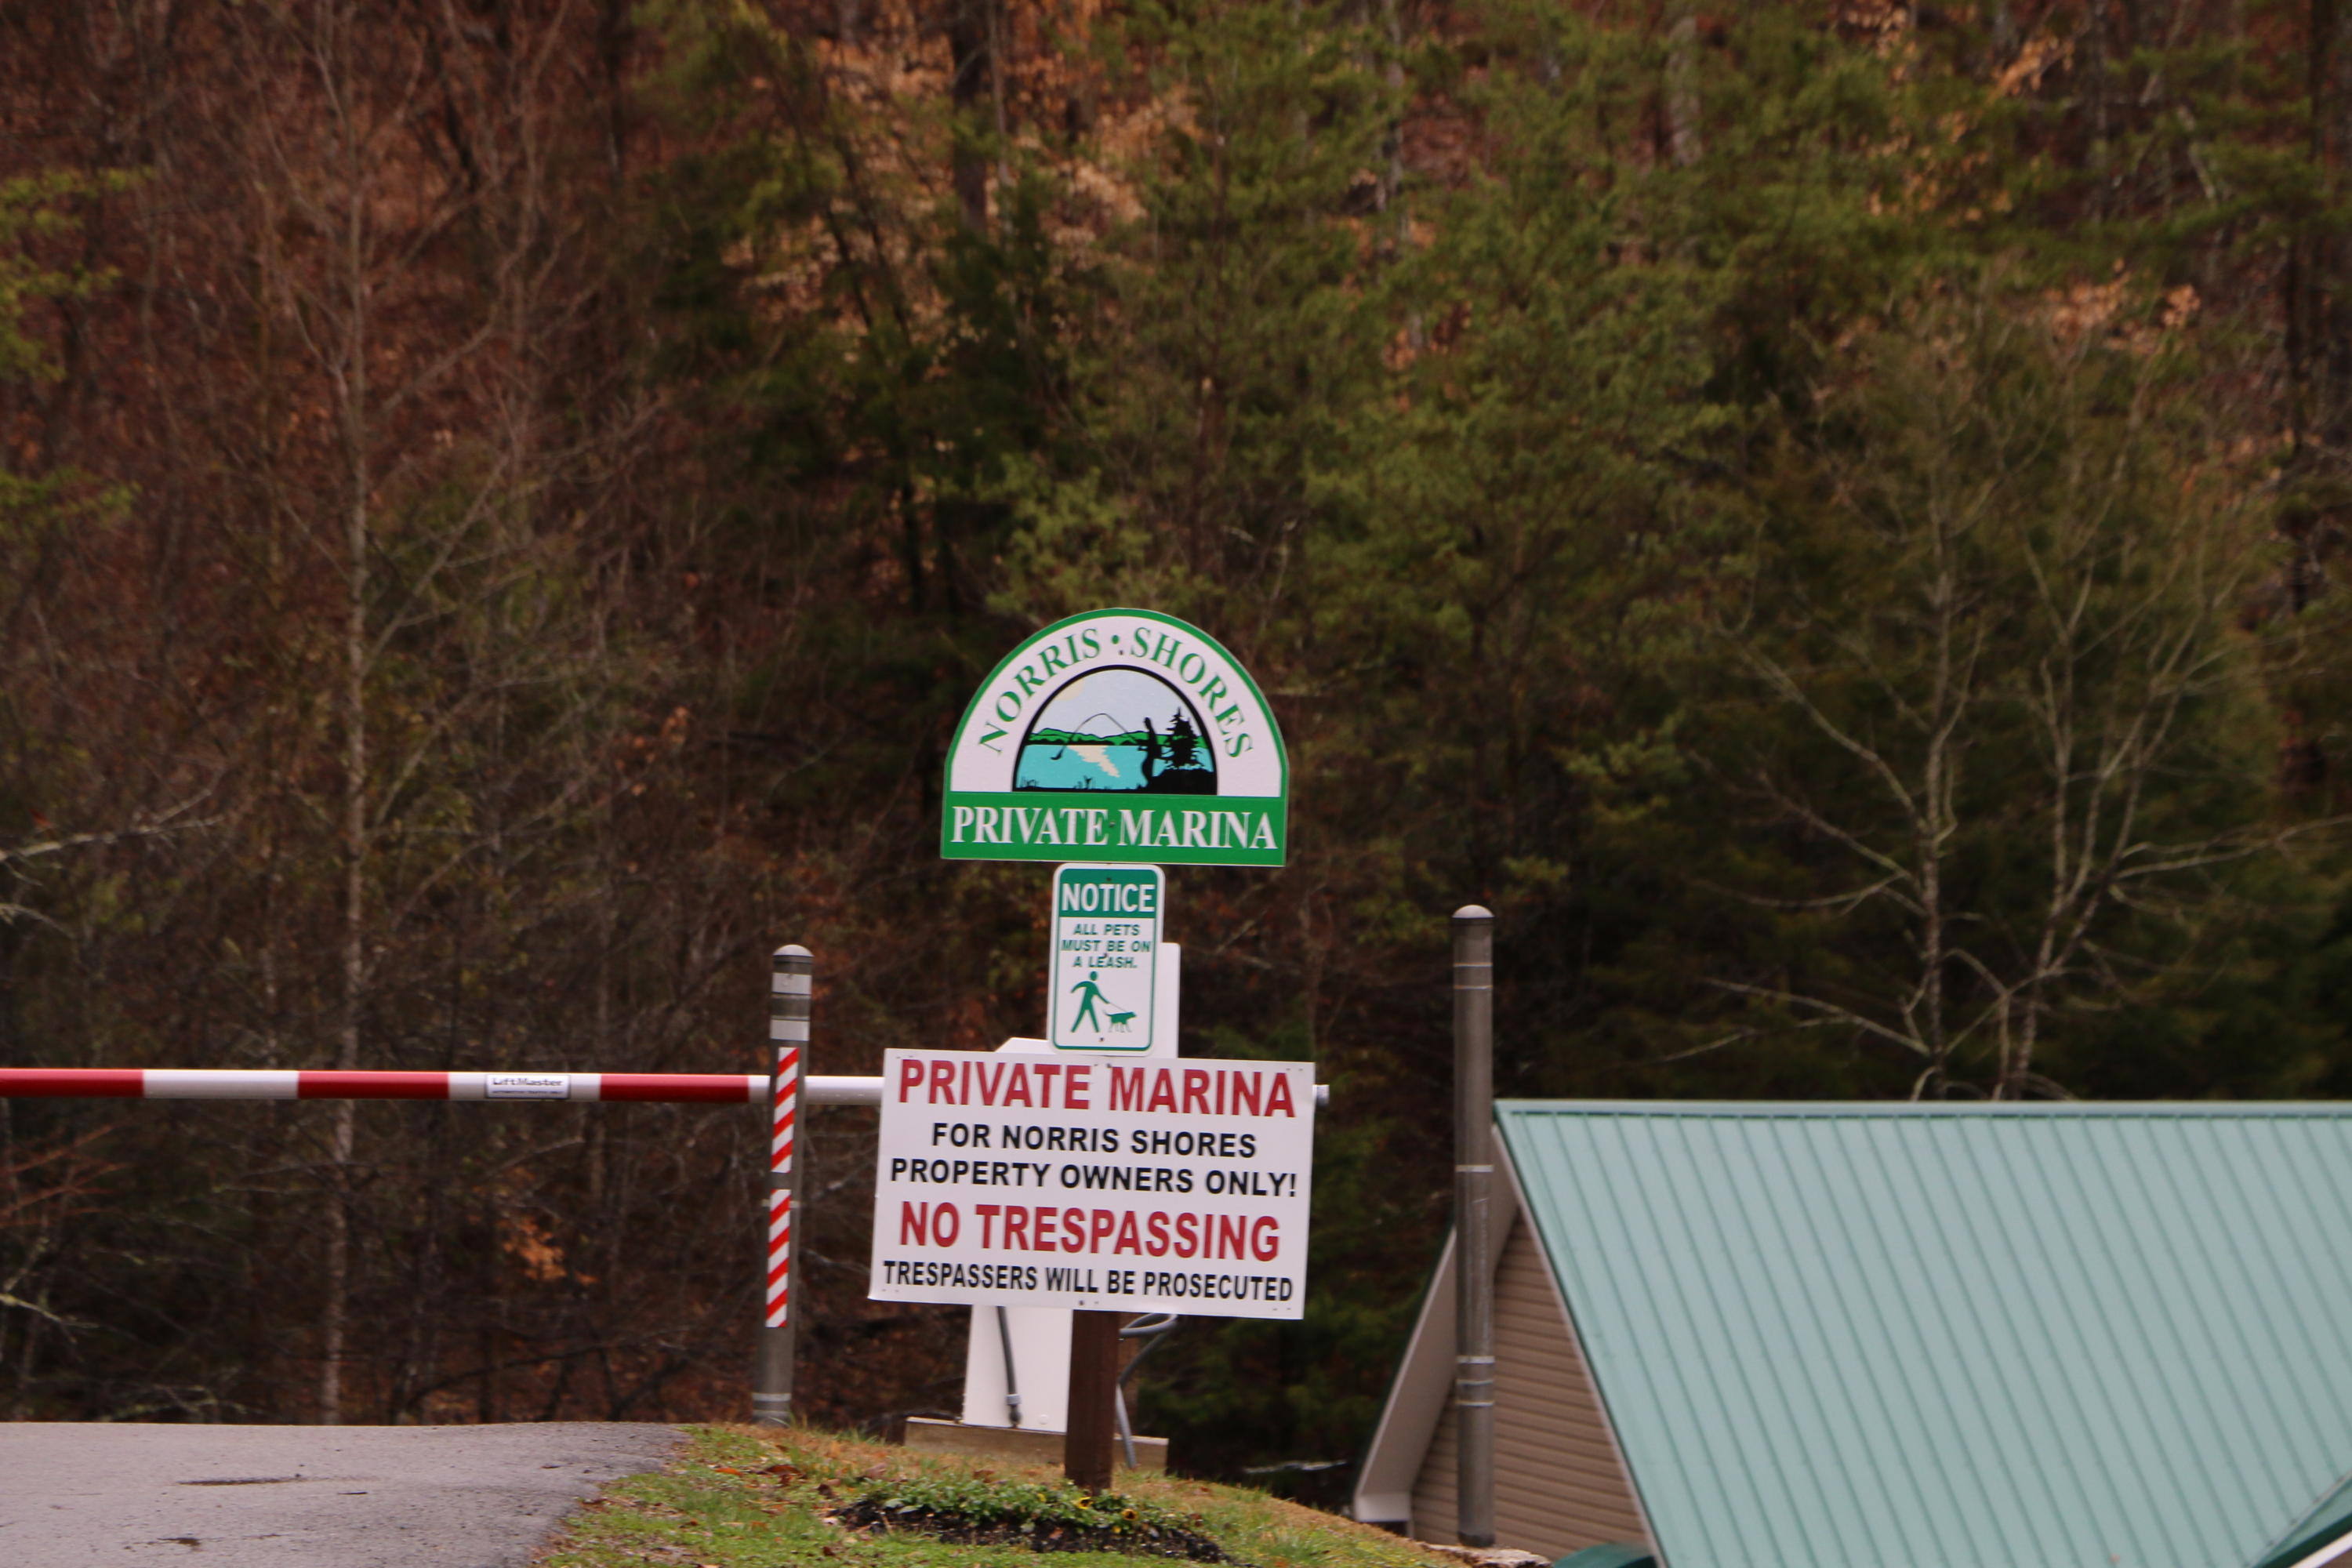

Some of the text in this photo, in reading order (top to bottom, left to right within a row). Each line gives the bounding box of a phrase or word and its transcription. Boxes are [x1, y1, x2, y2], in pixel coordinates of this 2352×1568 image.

[979, 627, 1254, 758] NORRIS SHORES
[951, 807, 1278, 849] PRIVATE MARINA
[1062, 883, 1155, 913] NOTICE
[1061, 939, 1150, 953] MUST BE ON
[1073, 924, 1140, 936] ALL PETS
[1073, 956, 1138, 968] A LEASH.
[899, 1059, 1296, 1118] PRIVATE MARINA
[932, 1123, 1256, 1158] FOR NORRIS SHORES
[891, 1157, 1297, 1197] PROPERTY OWNERS ONLY!
[900, 1201, 1279, 1261] NO TRESPASSING
[884, 1261, 1293, 1302] TRESPASSERS WILL BE PROSECUTED
